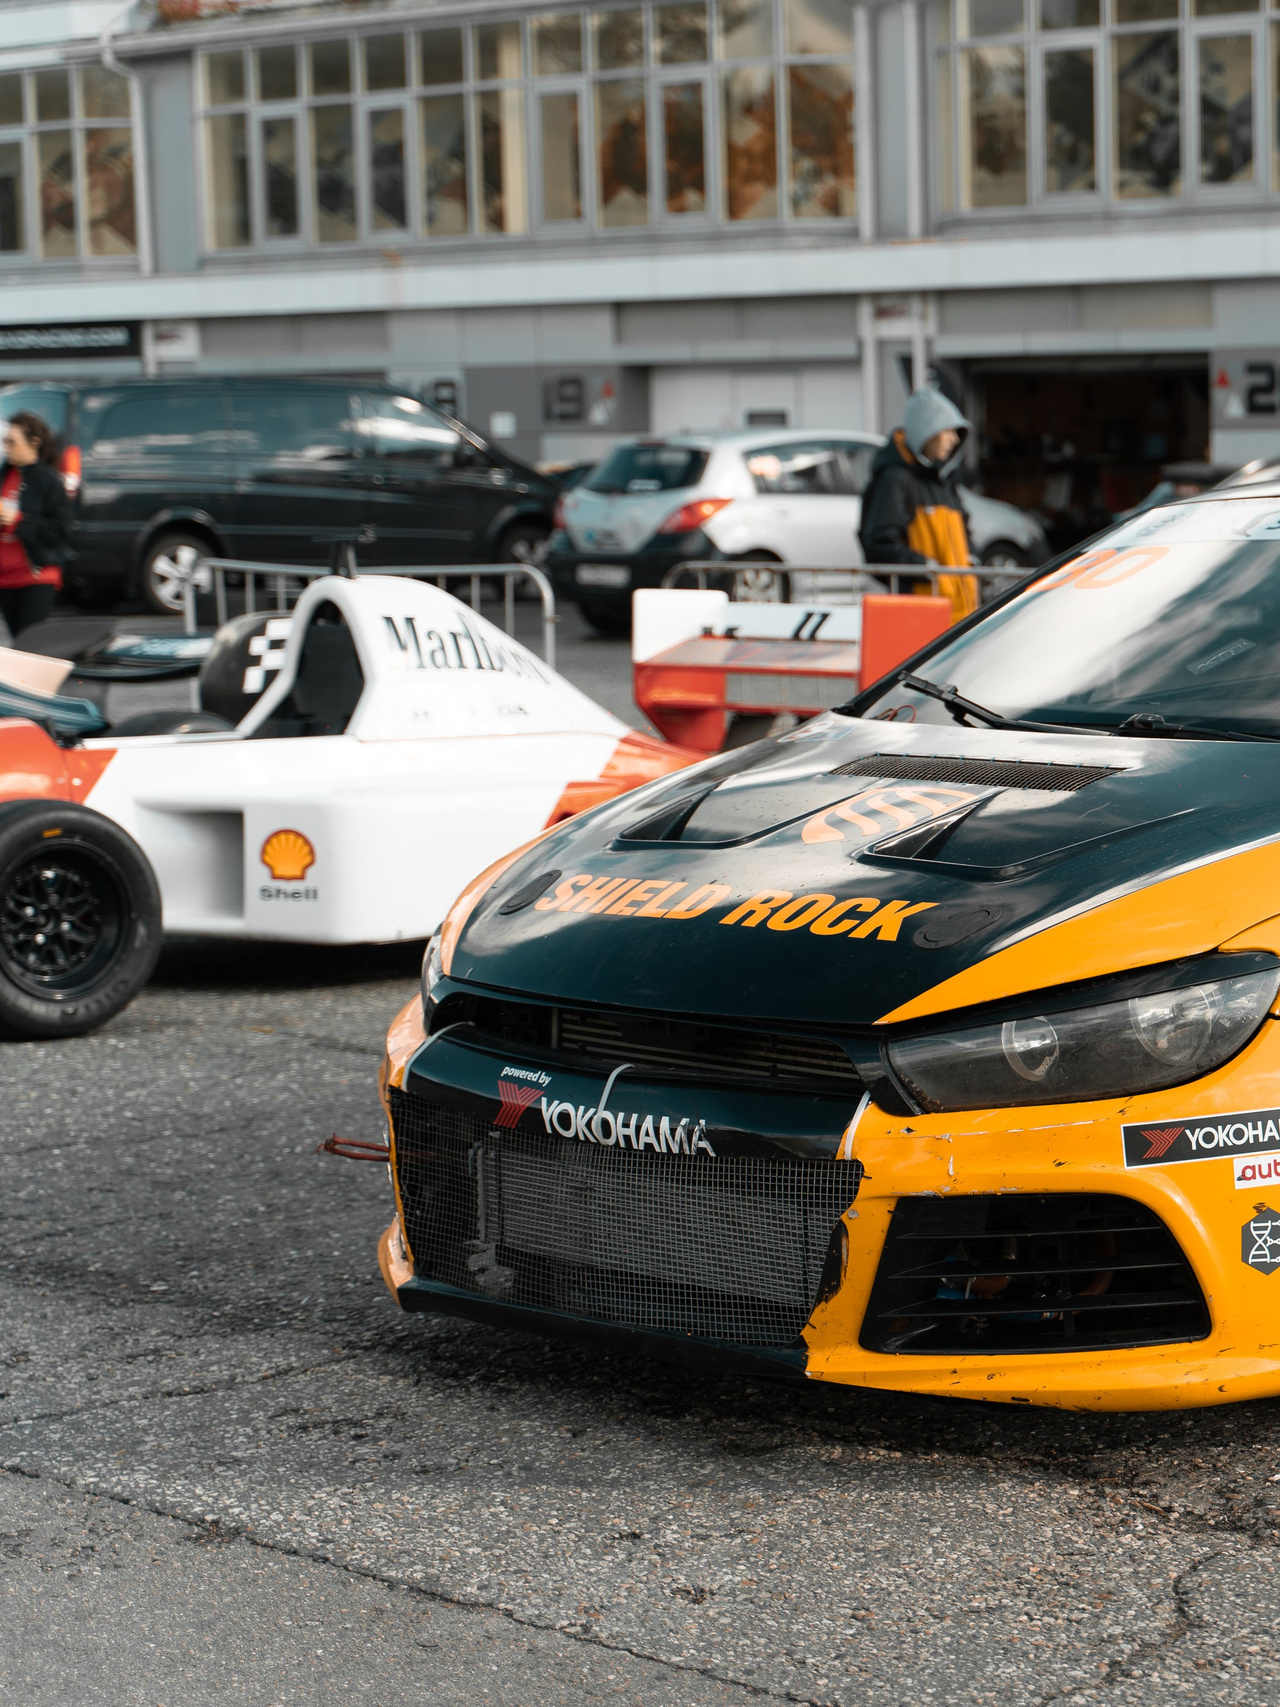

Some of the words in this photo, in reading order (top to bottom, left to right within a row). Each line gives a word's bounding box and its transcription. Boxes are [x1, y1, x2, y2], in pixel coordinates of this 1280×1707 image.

[259, 886, 318, 901] Shell
[534, 874, 732, 920] SHIELD
[718, 888, 940, 942] ROCK
[501, 1065, 538, 1082] powered
[538, 1072, 552, 1087] by
[541, 1096, 716, 1157] YOKOHAMA
